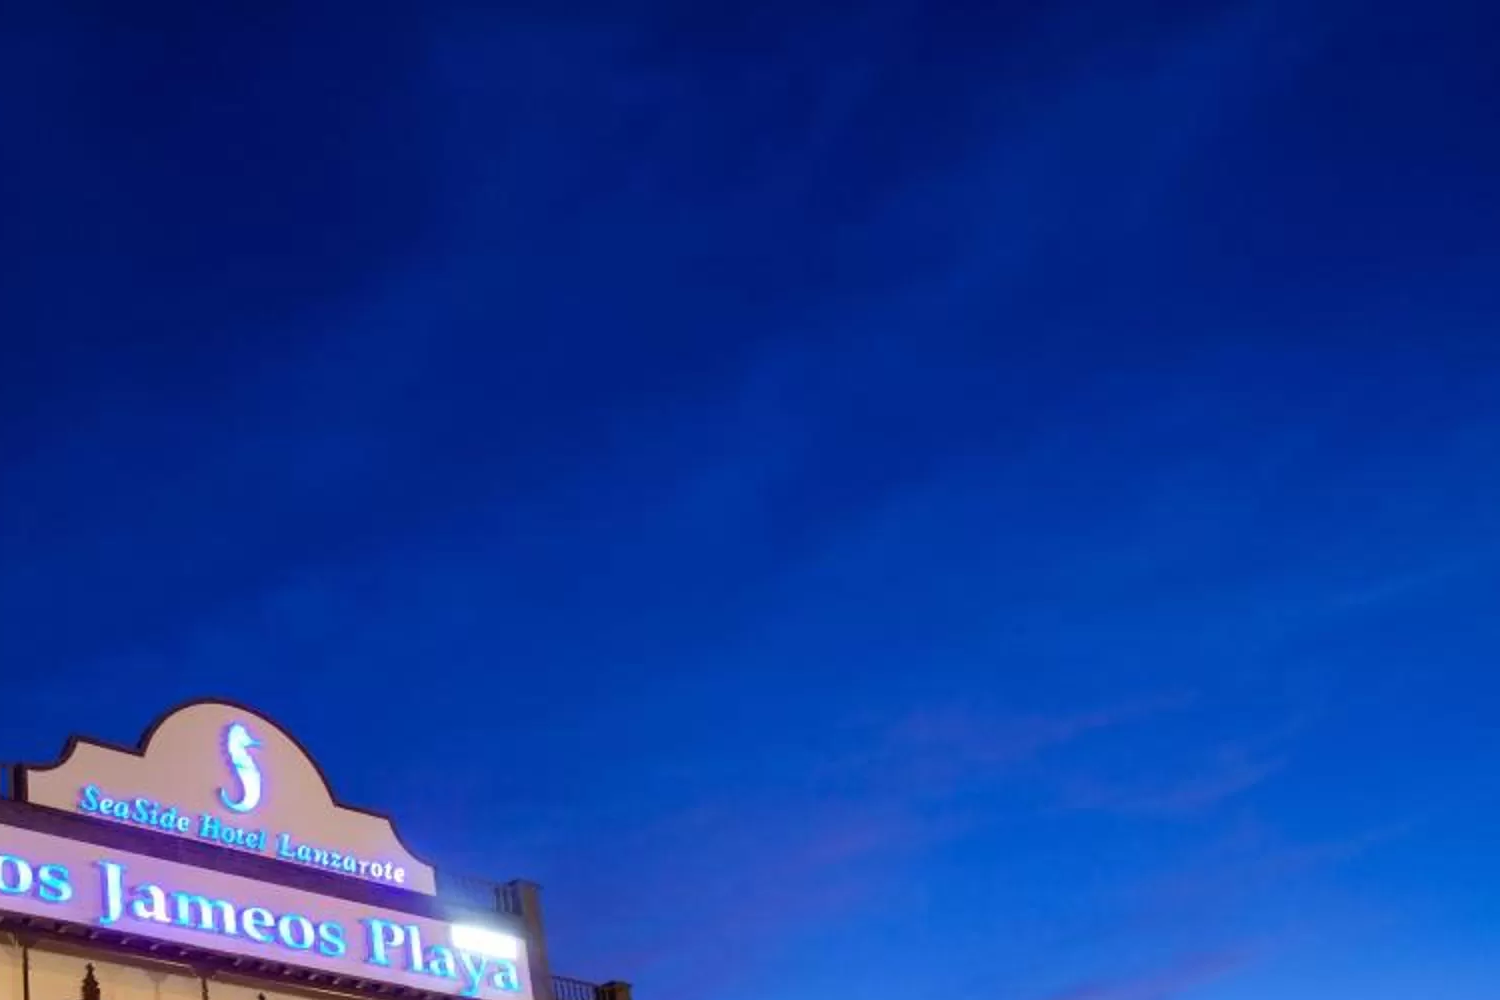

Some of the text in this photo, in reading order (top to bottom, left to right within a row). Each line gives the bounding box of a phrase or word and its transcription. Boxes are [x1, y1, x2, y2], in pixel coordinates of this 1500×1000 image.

[80, 783, 405, 883] SeaSide Hotel Lanzarote
[94, 859, 347, 957] Jameos
[360, 918, 521, 996] Playa
